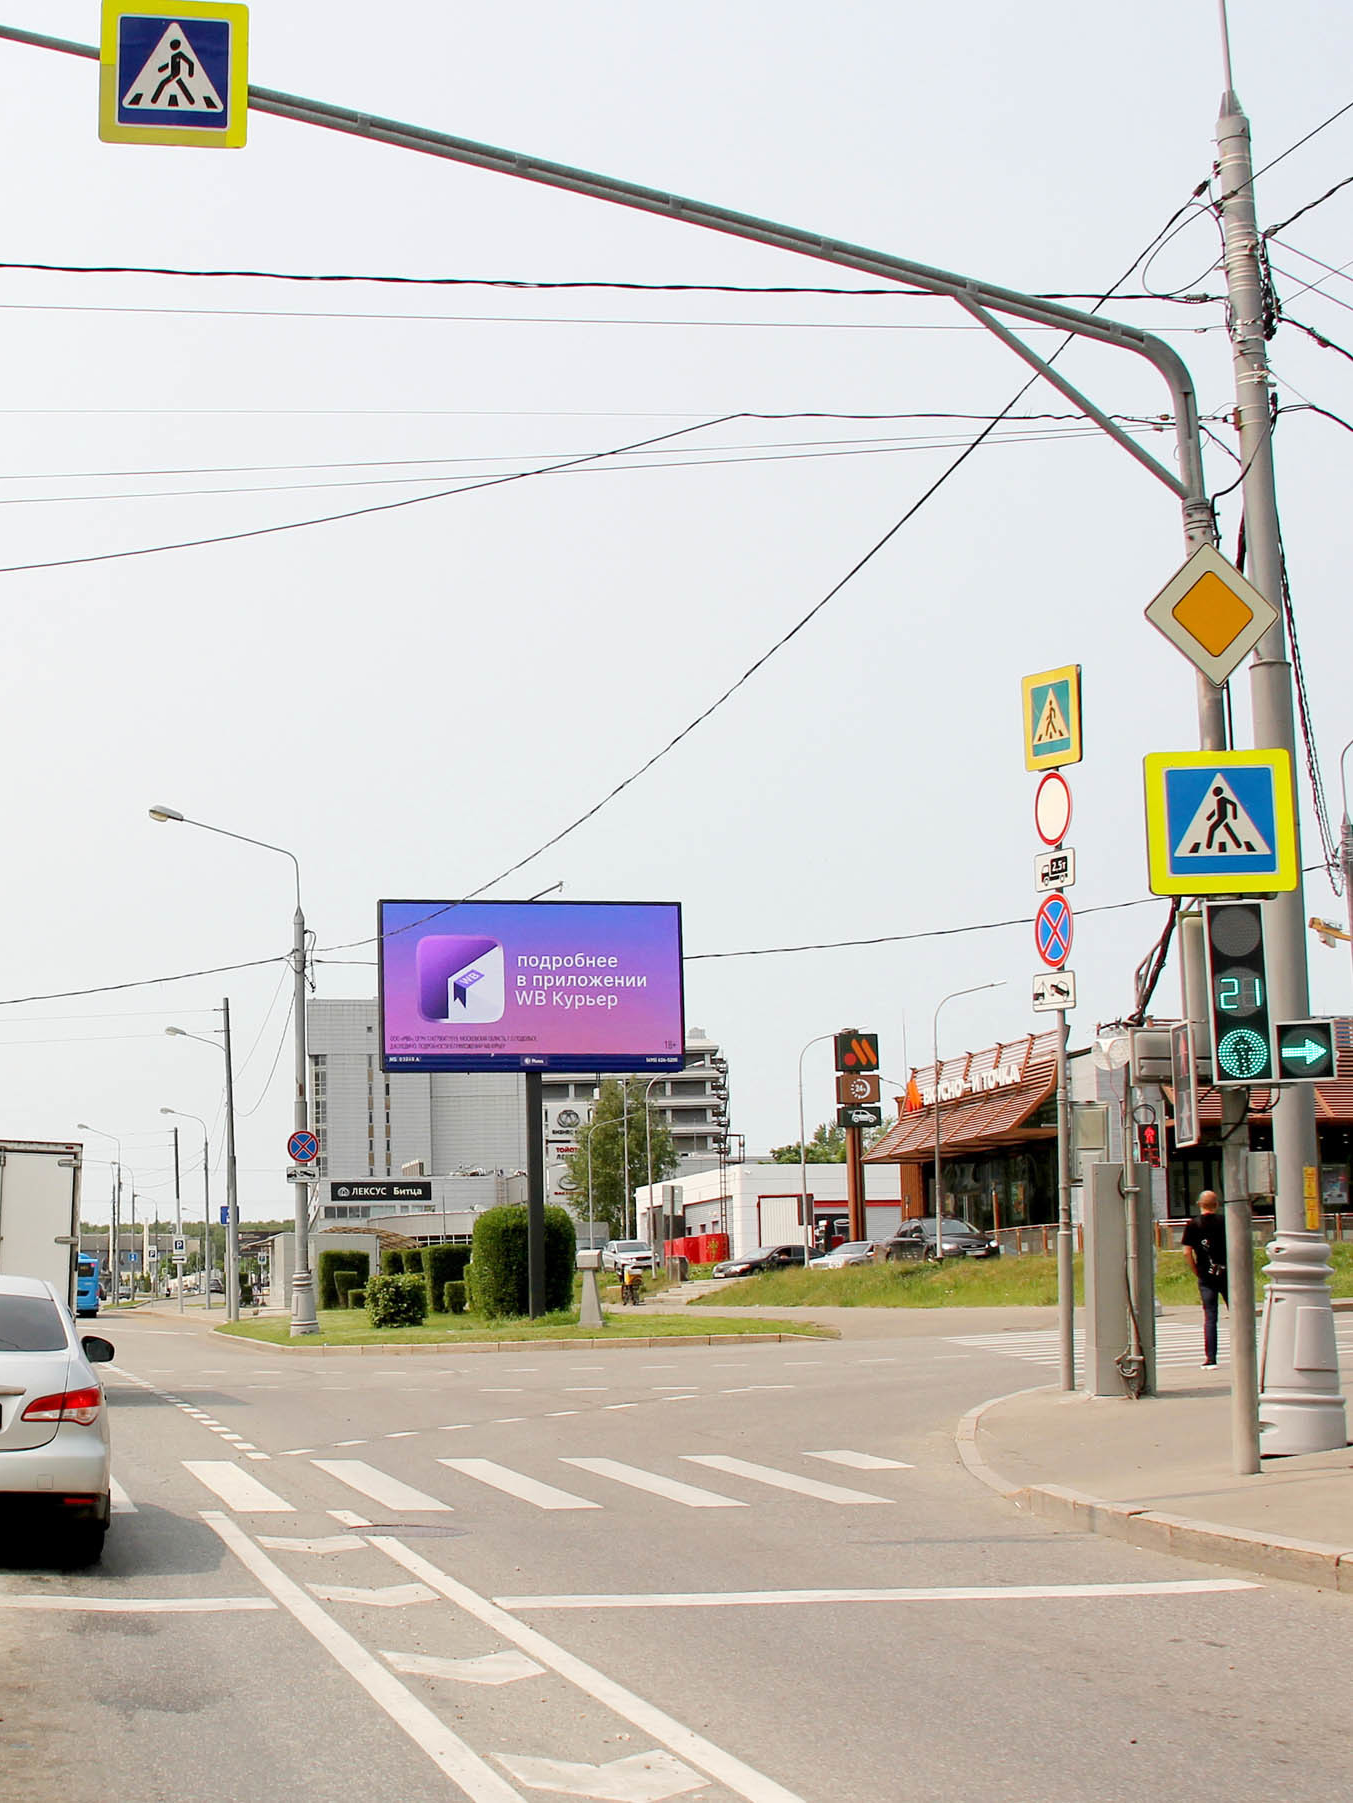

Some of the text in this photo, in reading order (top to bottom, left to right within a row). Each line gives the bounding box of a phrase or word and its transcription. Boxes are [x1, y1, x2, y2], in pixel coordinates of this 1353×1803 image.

[517, 953, 618, 971] подробнее
[459, 972, 479, 984] WB
[516, 975, 647, 990] в приложении
[515, 990, 618, 1009] WB Курьер
[1219, 978, 1262, 1009] 21
[663, 1040, 677, 1050] 18+
[982, 1064, 1022, 1091] ТОЧКА
[351, 1186, 423, 1197] ЛЕКСУС Битца
